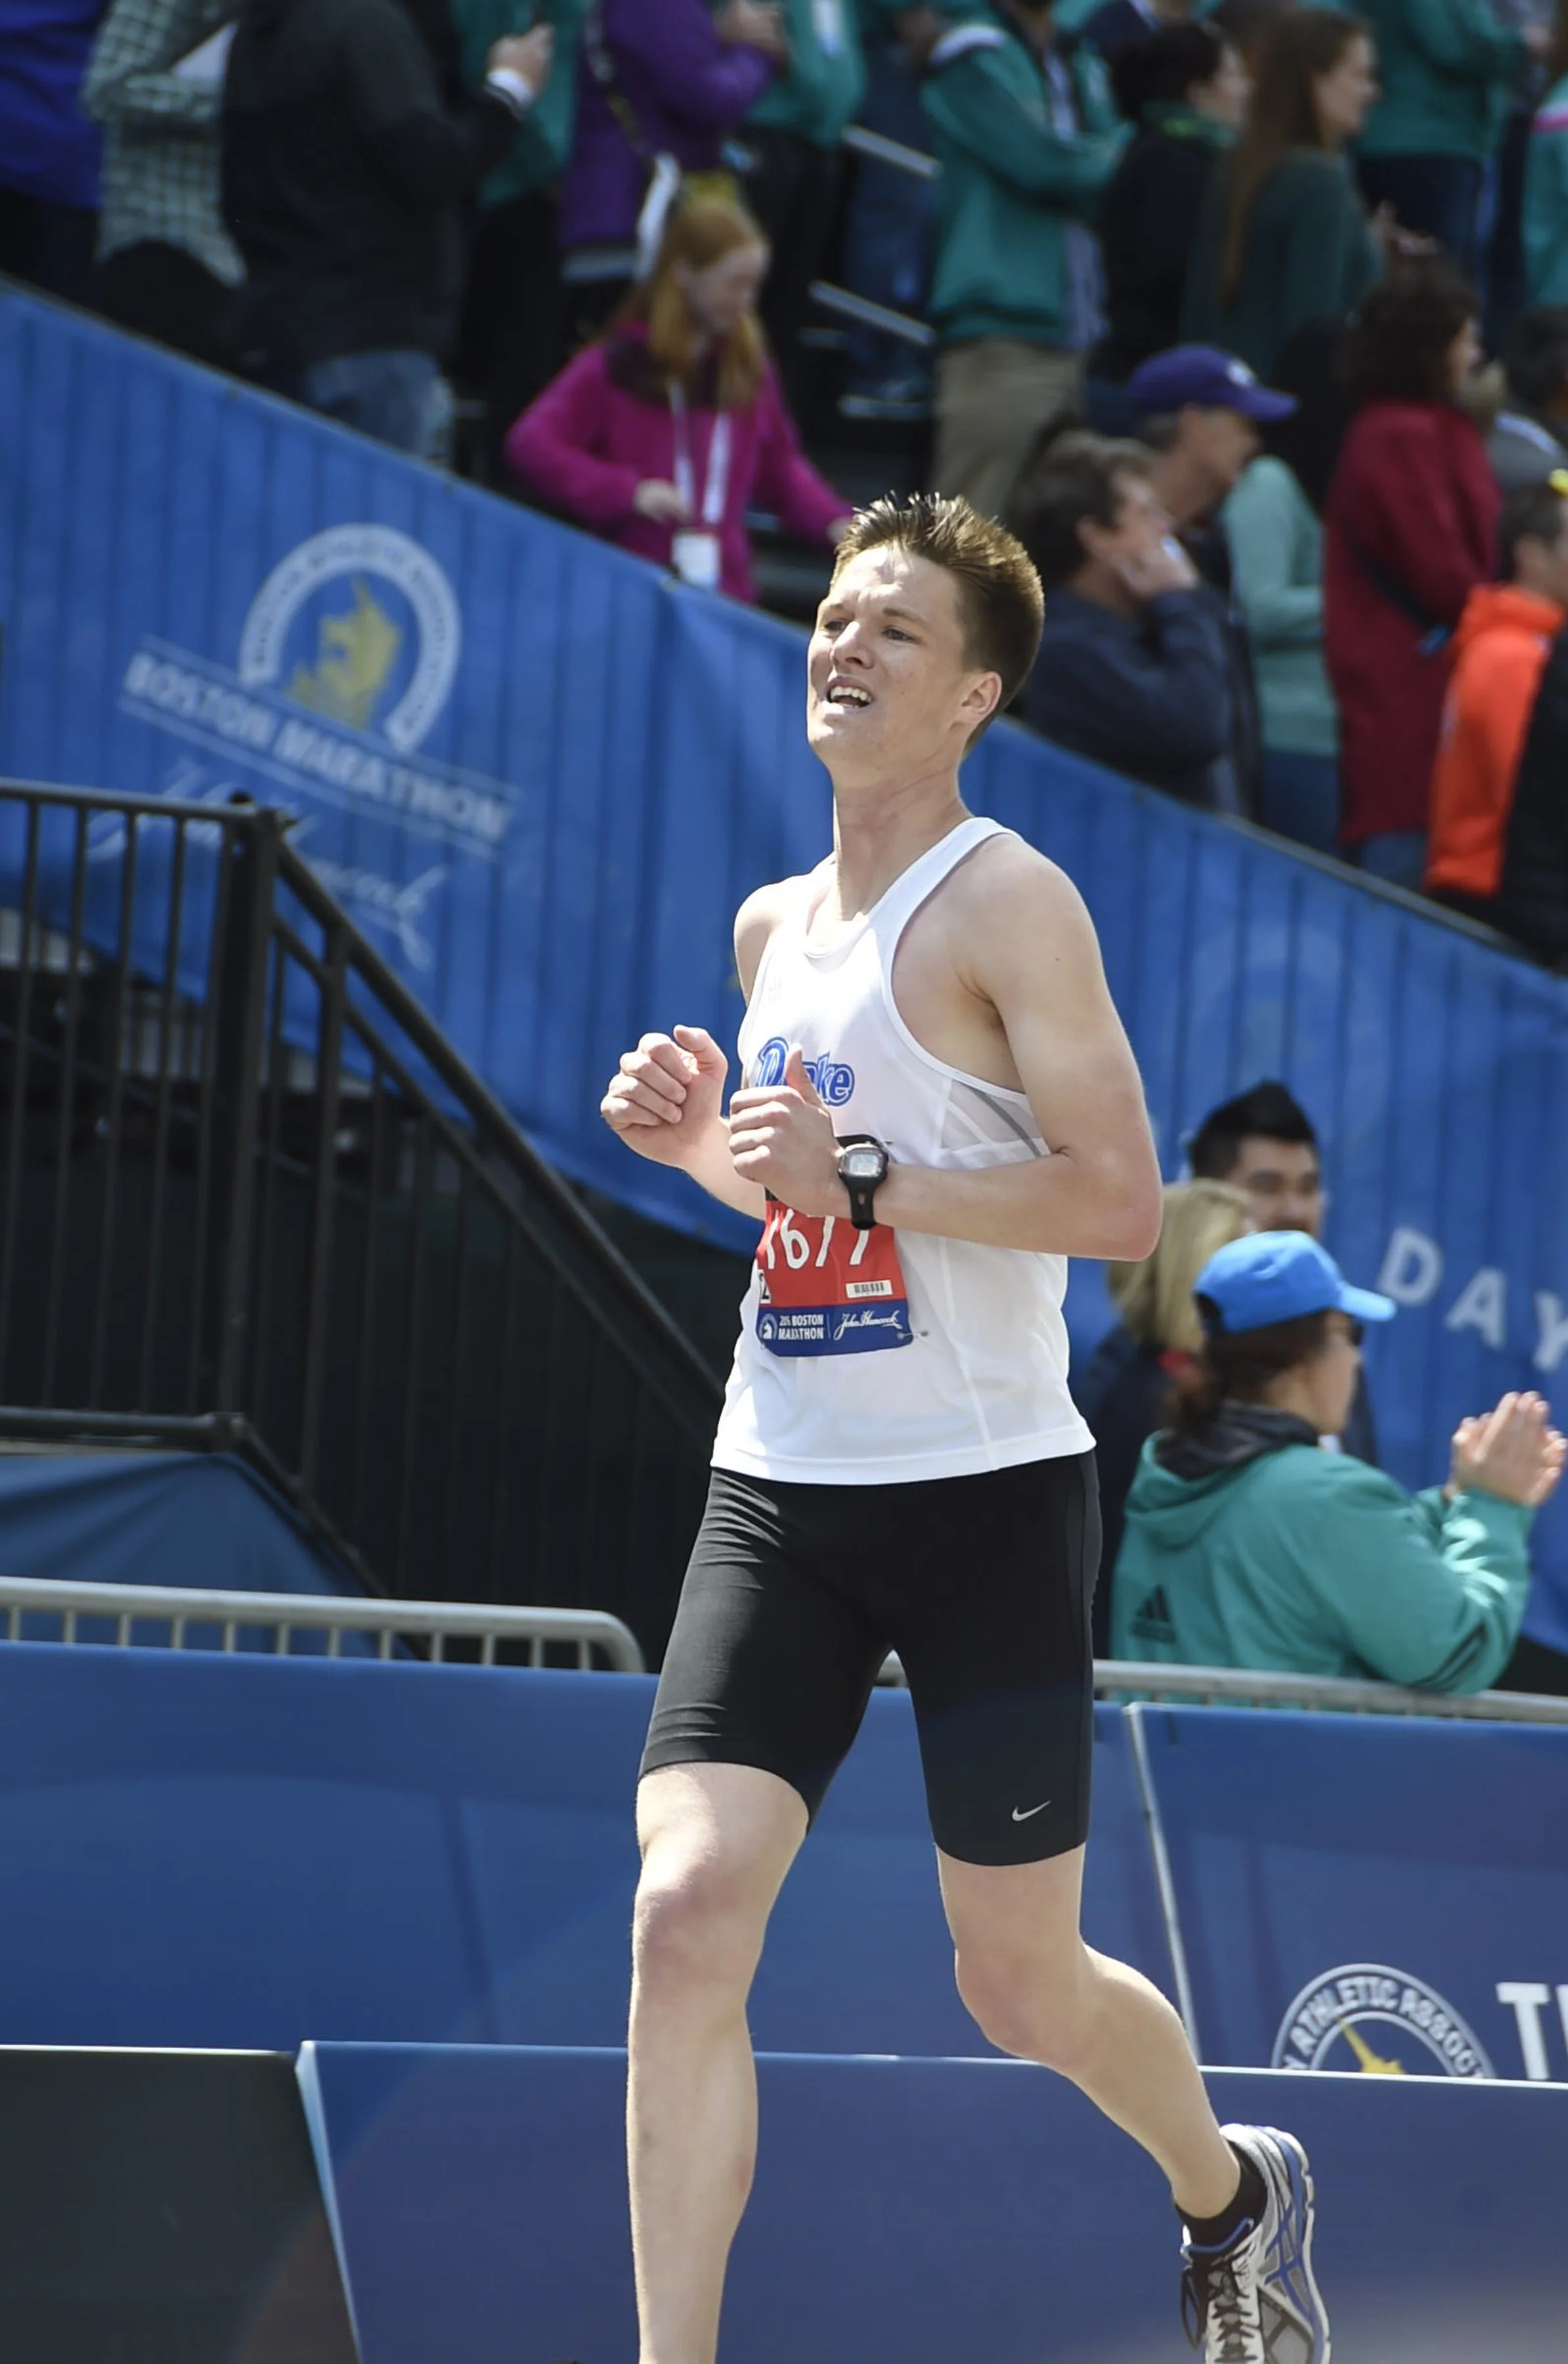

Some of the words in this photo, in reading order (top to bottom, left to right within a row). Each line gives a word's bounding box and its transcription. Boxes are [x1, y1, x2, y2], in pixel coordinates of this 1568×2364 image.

[123, 651, 277, 749] BOSTON
[274, 720, 512, 844] MARATHON
[792, 1314, 823, 1326] BOSTON
[1289, 1976, 1399, 2057] ATHLETIC
[1496, 1982, 1568, 2080] T
